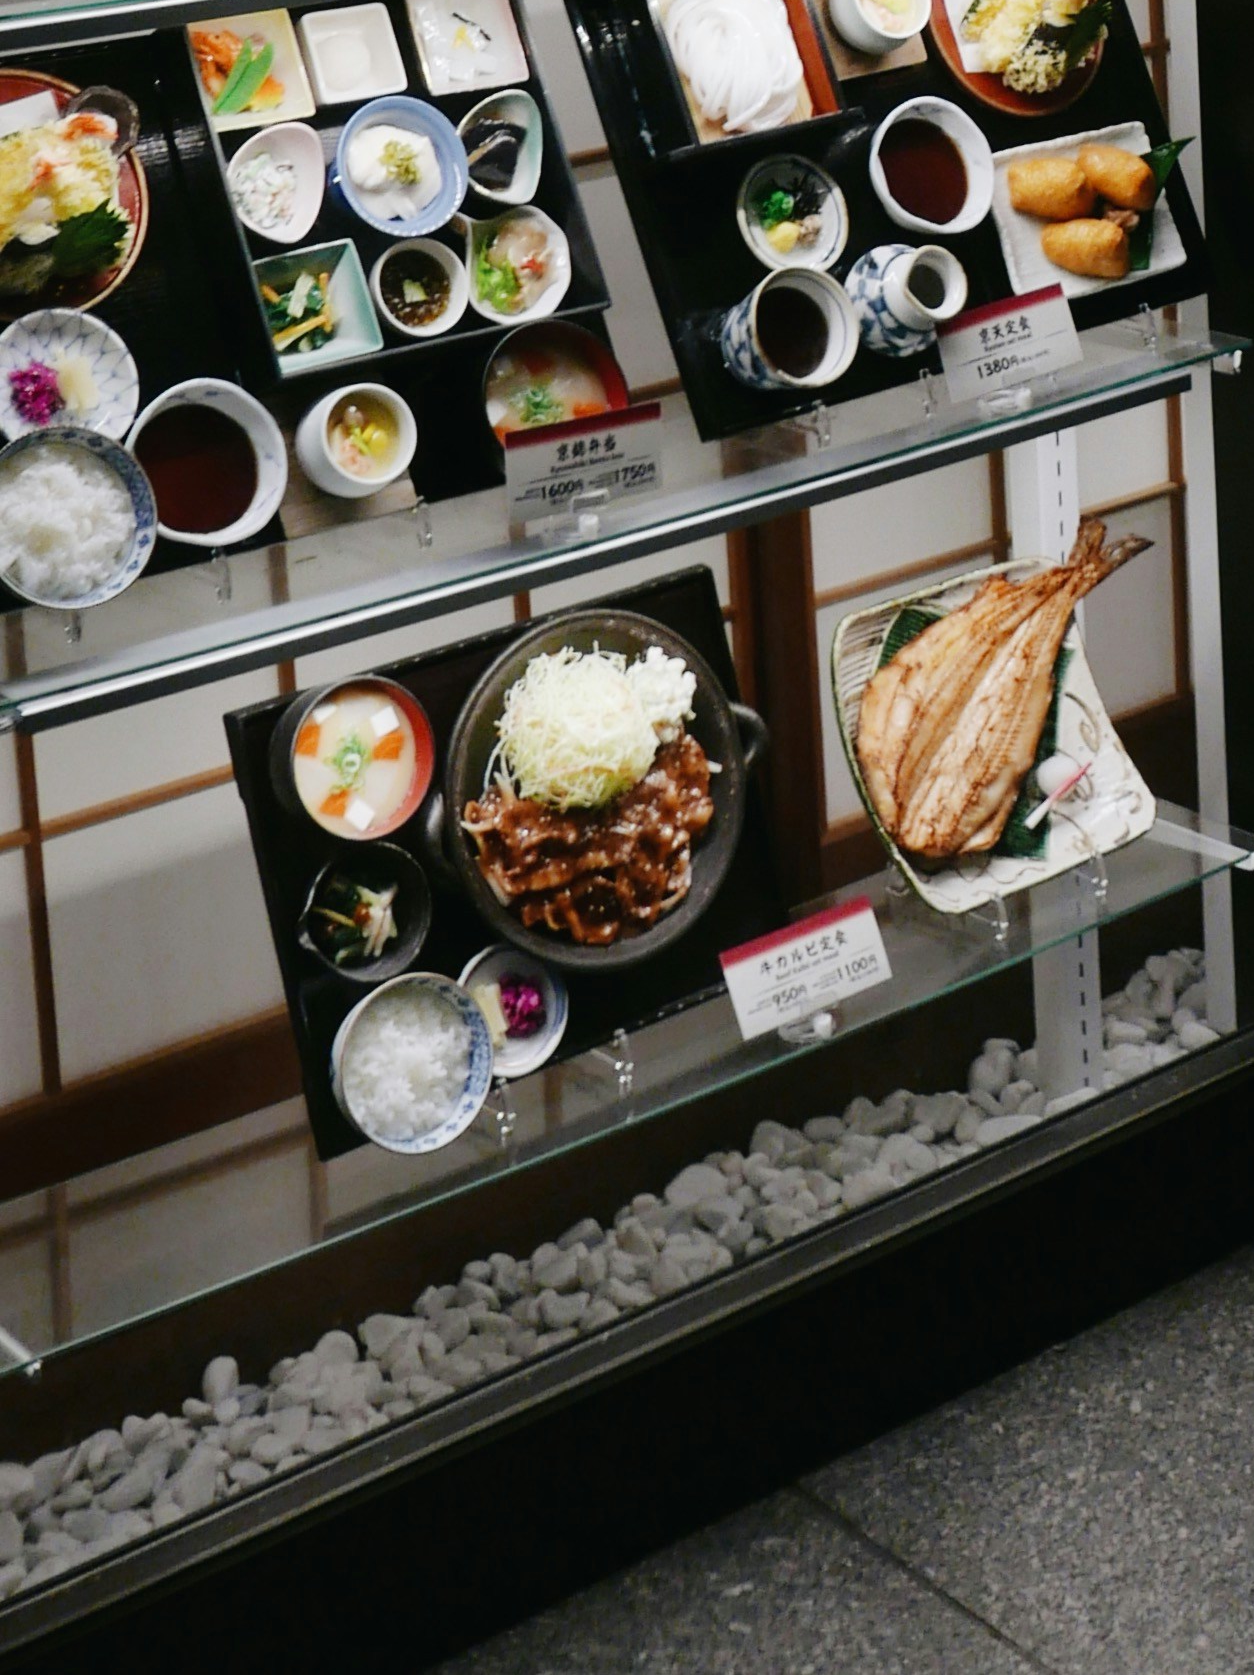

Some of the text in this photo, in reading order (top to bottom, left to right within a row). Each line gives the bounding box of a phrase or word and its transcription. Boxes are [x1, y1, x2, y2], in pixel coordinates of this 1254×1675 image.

[979, 316, 1032, 344] 京天定食
[976, 353, 1019, 378] 1380円
[615, 460, 655, 482] 1750円
[541, 477, 583, 499] 1600円
[760, 930, 848, 975] 牛カルビ定食
[837, 955, 877, 980] 1100円
[772, 983, 807, 1007] 950円
